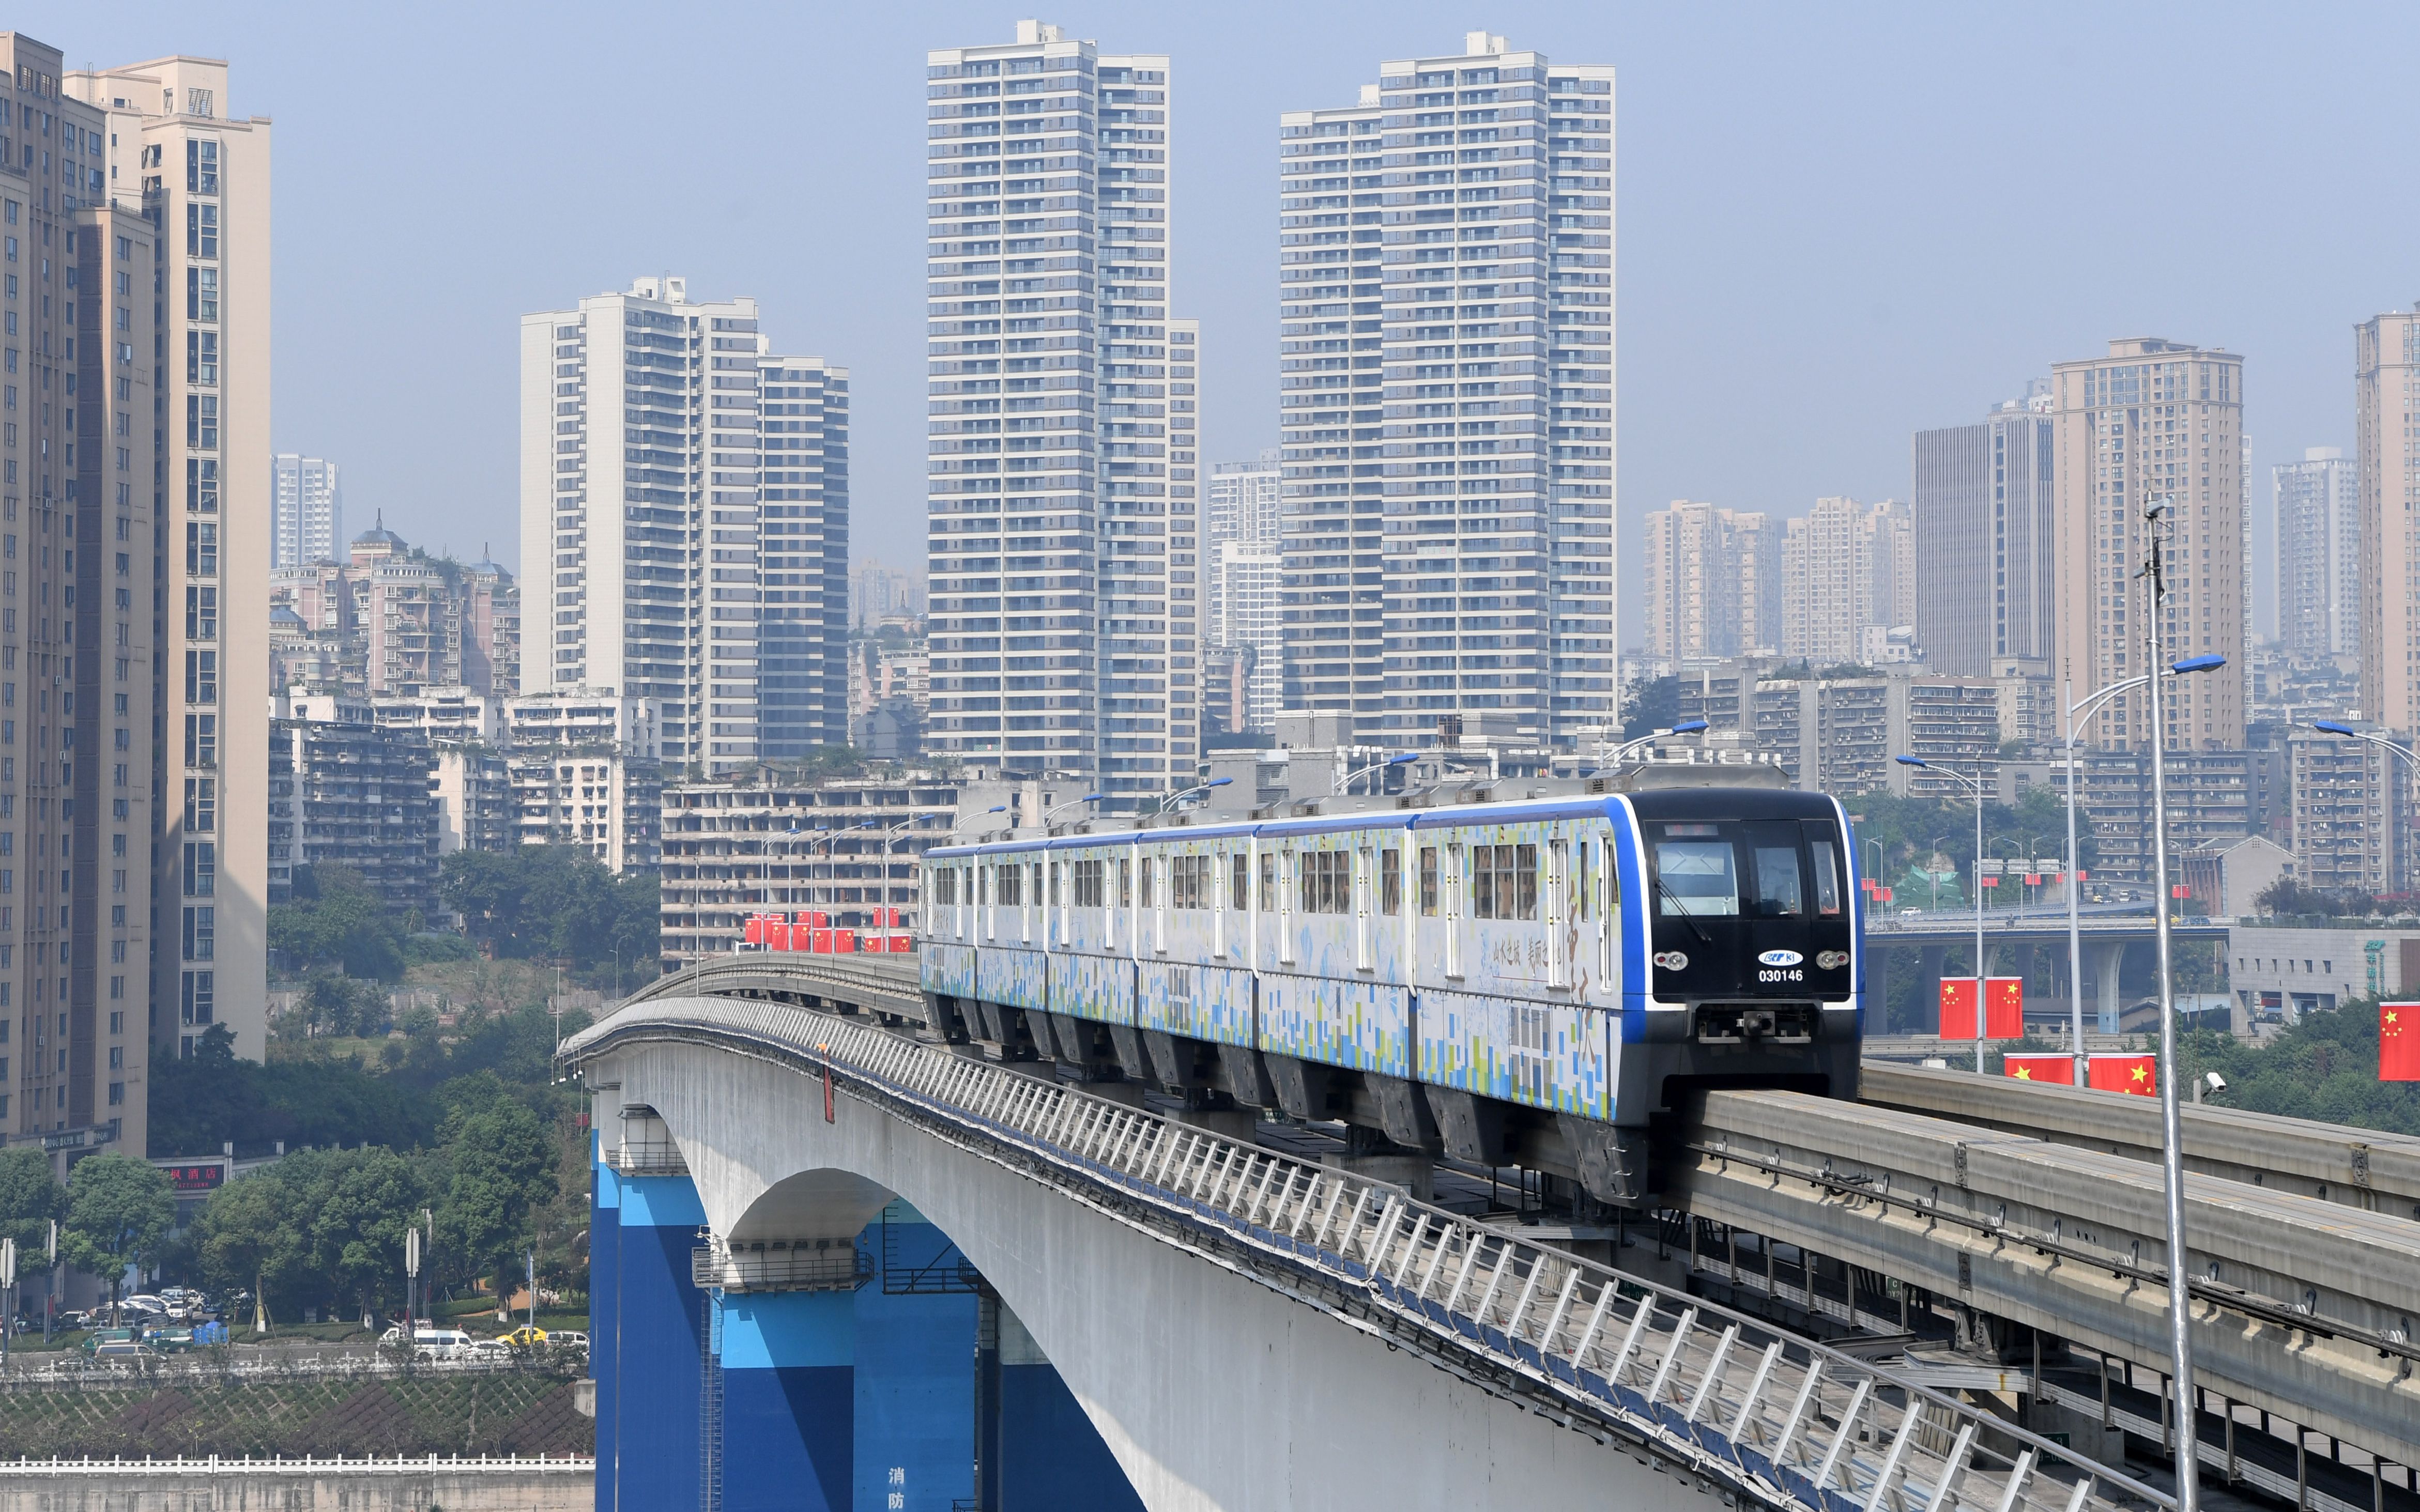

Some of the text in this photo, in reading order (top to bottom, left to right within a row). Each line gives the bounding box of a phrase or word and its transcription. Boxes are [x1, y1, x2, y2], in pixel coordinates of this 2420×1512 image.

[1494, 937, 1521, 966] 山水之城
[1759, 969, 1803, 982] 030146
[888, 1467, 905, 1509] 消防
